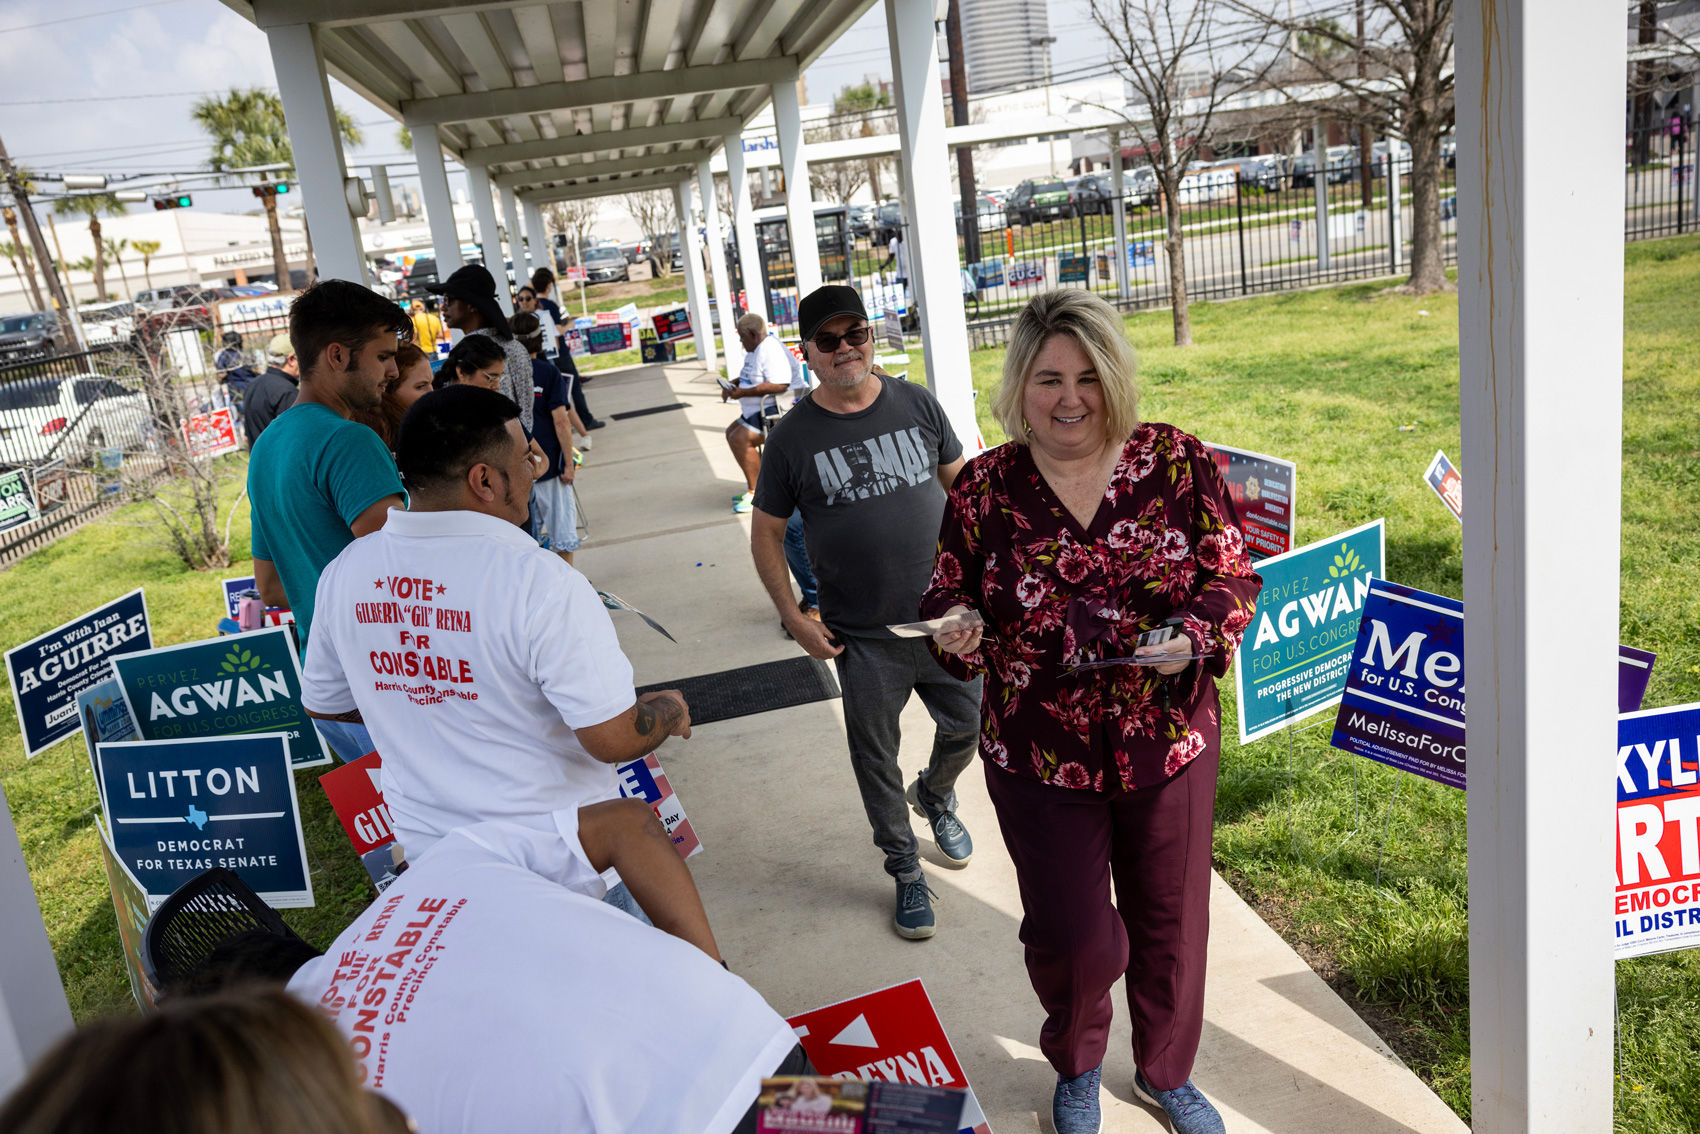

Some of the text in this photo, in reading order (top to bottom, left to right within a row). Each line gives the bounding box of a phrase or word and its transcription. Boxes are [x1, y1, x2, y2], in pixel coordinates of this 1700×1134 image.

[1008, 266, 1043, 281] GUCE
[1244, 533, 1285, 553] MY PRIORITY
[1245, 524, 1286, 545] YOUR SAFETY IS
[387, 576, 433, 601] VOTE
[436, 608, 472, 633] REYNA
[1253, 571, 1373, 651] AGWAN
[38, 612, 121, 658] I'm With Juan
[400, 631, 430, 650] FR
[19, 612, 146, 696] AGUIRRE
[370, 651, 474, 684] CONSABLE
[1253, 651, 1281, 674] FOR
[1286, 638, 1309, 661] U.S.
[1359, 618, 1466, 694] Me
[47, 688, 67, 703] Harris
[66, 677, 90, 692] County
[57, 668, 89, 688] Democrat
[88, 663, 100, 673] For
[137, 668, 200, 689] PERVEZ
[375, 681, 403, 692] Harris
[1257, 663, 1314, 699] PROGRESSIVE
[1314, 650, 1354, 676] DEMOCRA
[1276, 688, 1293, 703] THE
[1293, 677, 1313, 696] NEW
[1313, 664, 1348, 688] DISTRICT
[1361, 668, 1385, 687] for
[1388, 676, 1418, 699] U.S.
[150, 670, 291, 721] AGWAN
[407, 694, 447, 706] Precinc
[153, 725, 184, 739] FOR
[214, 704, 298, 730] CONGRESS
[1349, 736, 1371, 748] POLITICAL
[1371, 744, 1409, 760] ADVERTISEMENT
[1408, 755, 1420, 764] PAID
[1420, 759, 1430, 767] FOR
[1436, 765, 1457, 776] MELISSA
[1616, 732, 1700, 794] KYL
[127, 766, 260, 799] LITTON
[664, 813, 680, 826] DAY
[157, 838, 244, 852] DEMOCRAT
[136, 855, 278, 870] FOR TEXAS SENATE
[365, 894, 405, 942] REYNA
[346, 955, 384, 1009] FOR
[374, 897, 468, 1088] Harris County Constable
[396, 956, 438, 1023] Precinct
